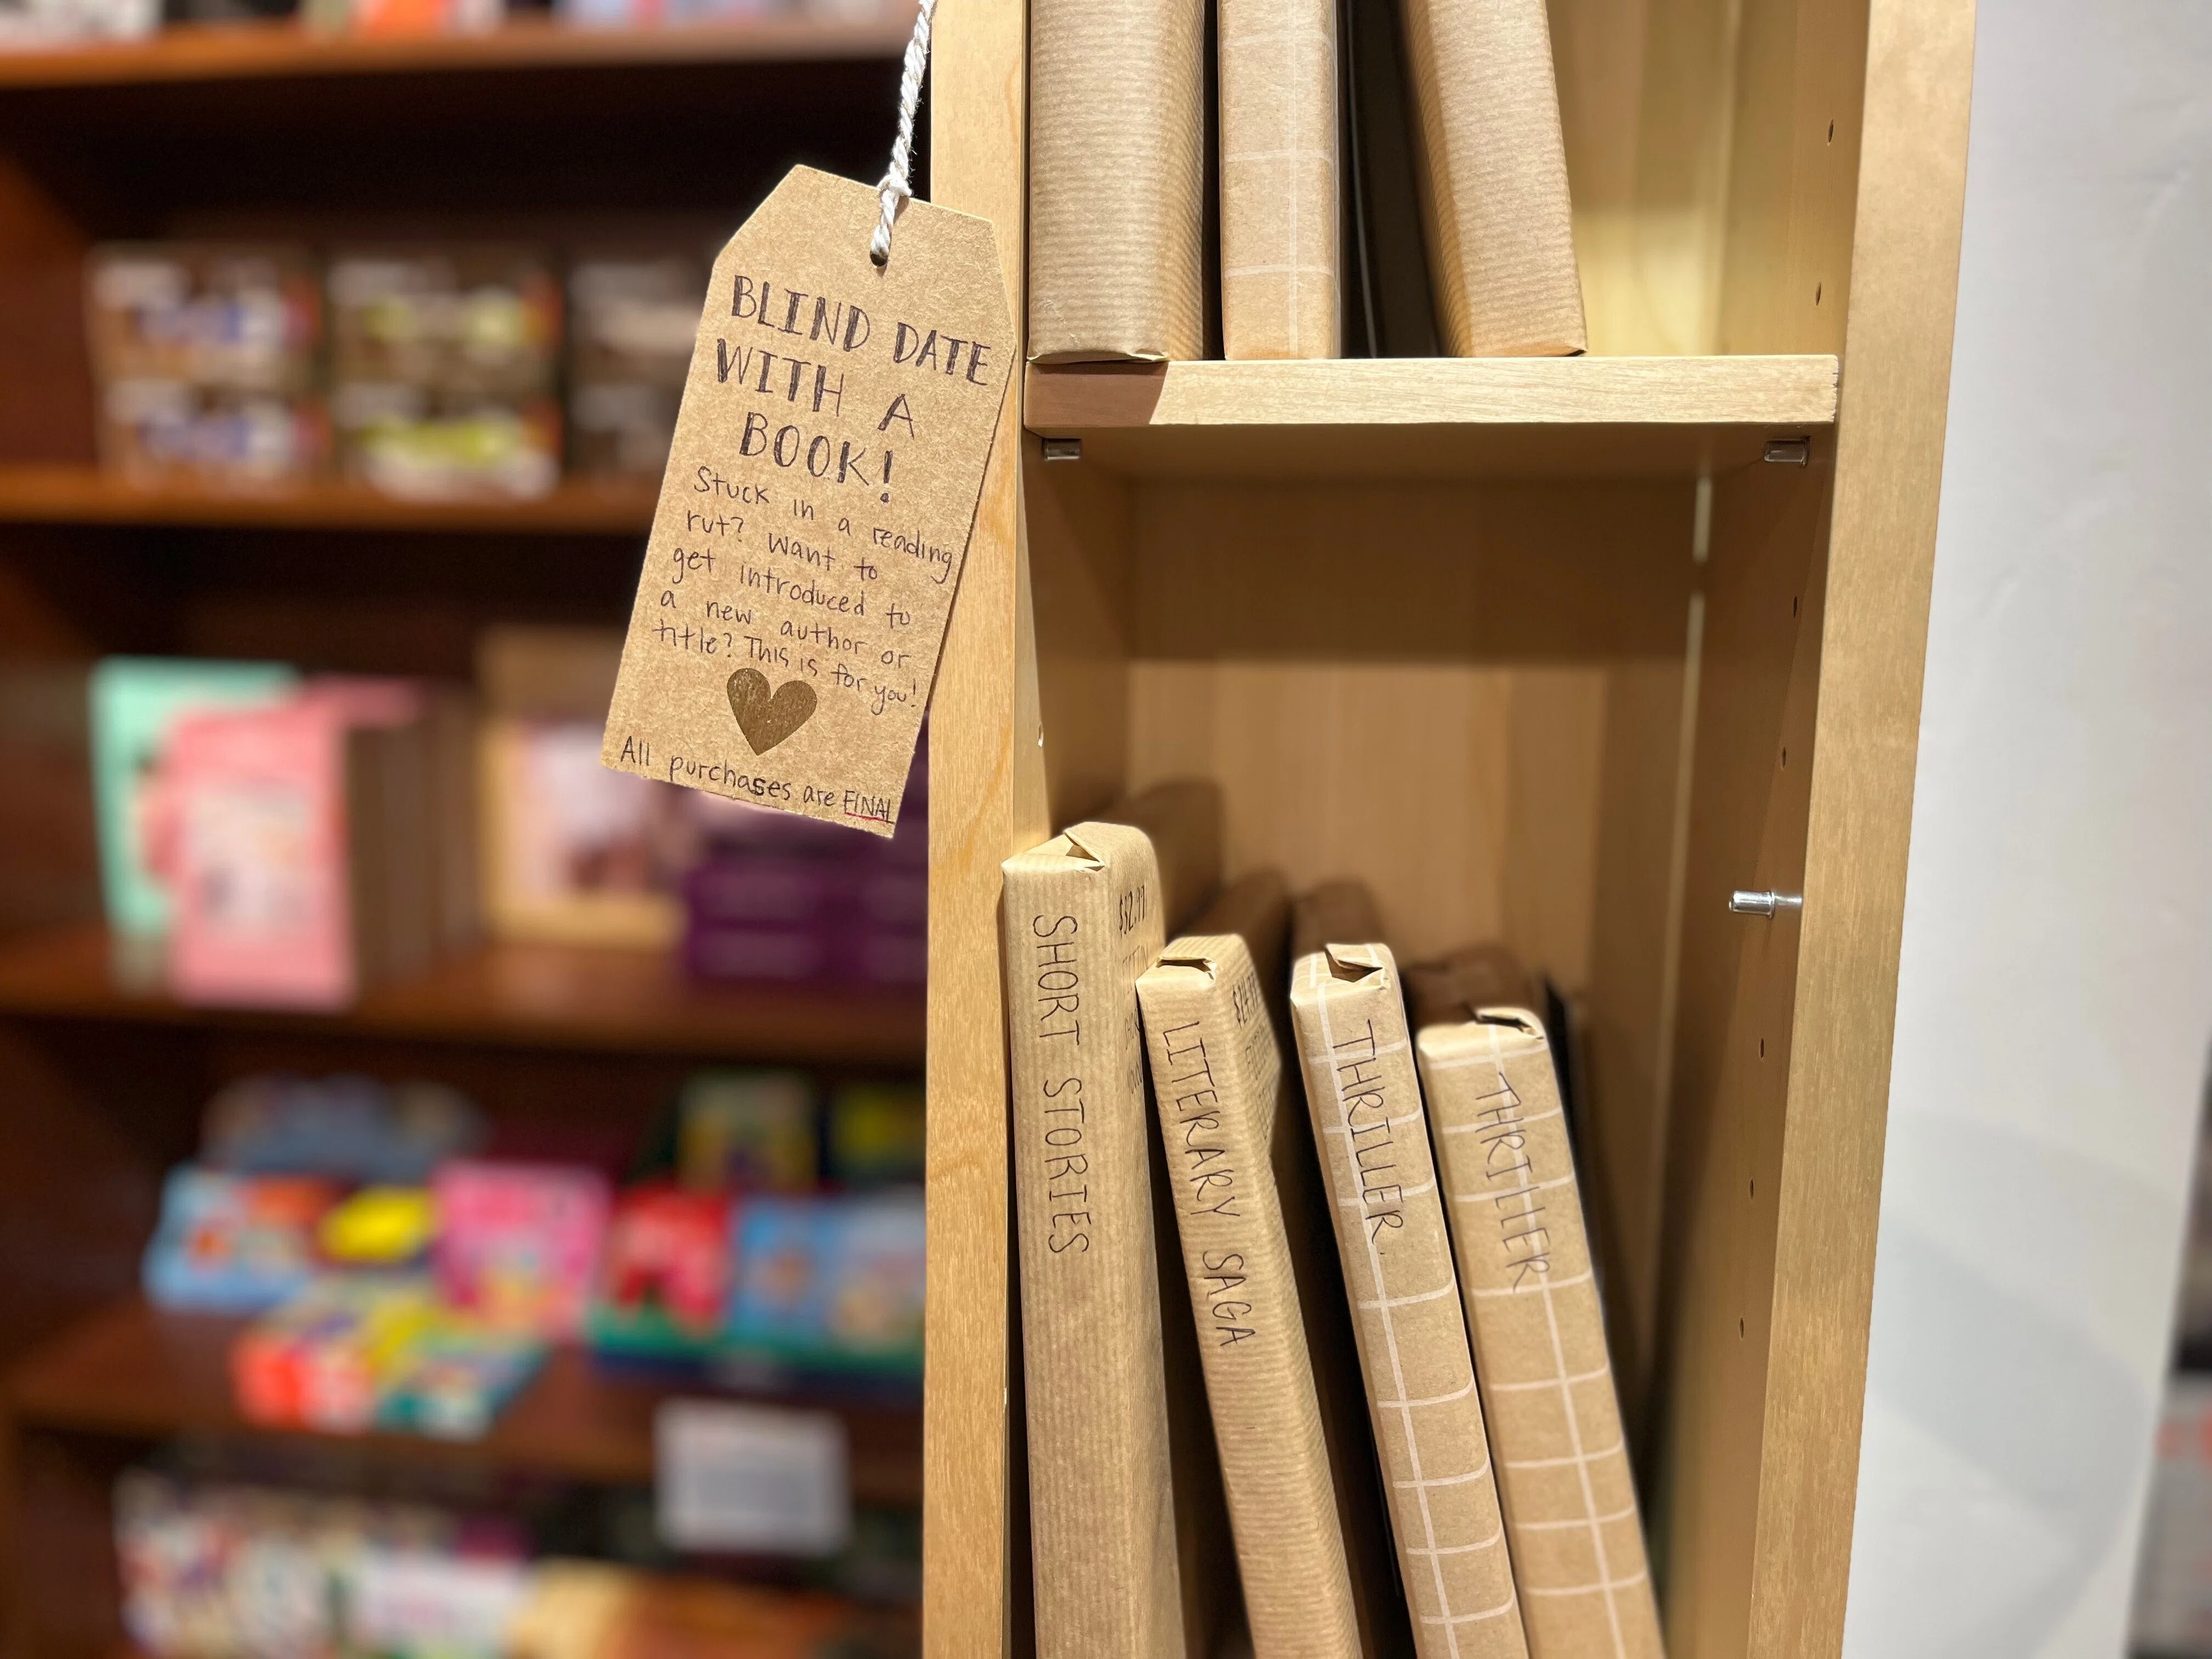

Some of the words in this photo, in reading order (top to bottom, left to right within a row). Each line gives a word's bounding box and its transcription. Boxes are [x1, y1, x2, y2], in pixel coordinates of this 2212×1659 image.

[731, 275, 871, 352] BLIND
[894, 321, 991, 386] DATE
[717, 338, 845, 417] WITH
[878, 393, 915, 439] A
[739, 411, 894, 503] BOOK!
[686, 510, 744, 542] rut?
[854, 557, 878, 582] to
[693, 466, 770, 504] Stuck
[793, 498, 815, 521] in
[838, 517, 851, 536] a
[873, 527, 953, 584] reading
[661, 590, 676, 609] a
[706, 600, 752, 625] new
[780, 620, 866, 655] author
[881, 649, 913, 668] or
[673, 547, 715, 584] get
[740, 564, 865, 617] introduced
[886, 603, 911, 629] to
[652, 618, 732, 658] title?
[743, 635, 789, 668] This
[800, 657, 818, 677] is
[830, 666, 866, 692] for
[873, 682, 917, 716] you!
[620, 736, 650, 767] All
[669, 755, 792, 801] purchases
[803, 785, 836, 807] are
[843, 789, 896, 825] FINAL
[1032, 915, 1080, 1046] SHORT
[1042, 1077, 1092, 1254] STORIES
[1162, 1021, 1242, 1218] LITERARY
[1332, 1019, 1404, 1244] THRILLER
[1475, 1071, 1551, 1293] THRILLER
[1201, 1252, 1256, 1347] SAGA
